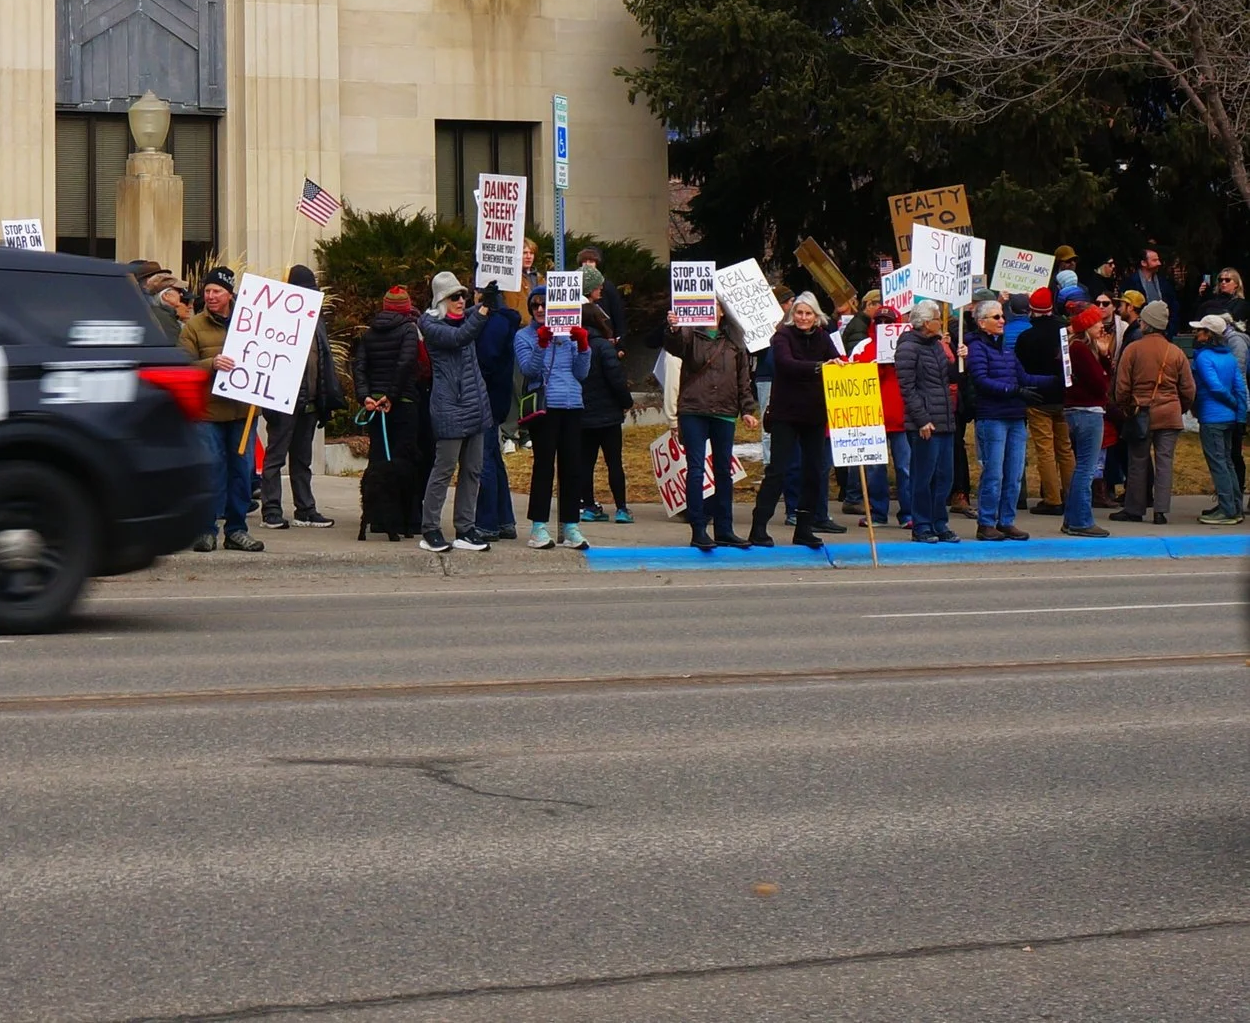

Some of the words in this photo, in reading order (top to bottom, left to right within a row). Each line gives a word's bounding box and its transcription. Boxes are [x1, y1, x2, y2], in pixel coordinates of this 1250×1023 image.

[484, 180, 519, 201] DAINES
[894, 187, 962, 216] FEALTY
[483, 202, 517, 221] SHEEHY
[912, 210, 956, 226] TO
[4, 224, 23, 235] STOP
[25, 223, 40, 234] U.S.
[485, 221, 514, 241] ZINKE
[6, 236, 28, 248] WAR
[30, 235, 42, 247] ON
[957, 241, 972, 260] LOCK
[1017, 252, 1033, 262] NO
[673, 266, 694, 278] STOP
[697, 266, 713, 278] U.S.
[956, 260, 972, 279] THEM
[1002, 258, 1030, 270] FOREIGN
[1034, 265, 1049, 277] WARS
[548, 276, 566, 287] STOP
[568, 276, 580, 287] U.S.
[673, 278, 697, 292] WAR
[700, 278, 713, 292] ON
[717, 268, 754, 289] REAL
[884, 268, 910, 296] DUMP
[958, 279, 969, 296] UP!
[253, 284, 304, 314] NO
[548, 288, 567, 302] WAR
[569, 288, 580, 302] ON
[722, 279, 770, 304] AMERICANS
[884, 289, 912, 309] TRUMP
[674, 306, 715, 317] VENEZUELA
[734, 292, 774, 318] RESPECT
[236, 306, 301, 346] Blood
[547, 316, 580, 326] VENEZUELA
[747, 312, 767, 326] THE
[242, 340, 291, 371] for
[229, 367, 275, 400] OIL
[827, 378, 860, 398] HANDS
[862, 377, 877, 396] OFF
[827, 405, 884, 429] VENEZUELA
[651, 442, 670, 478] US
